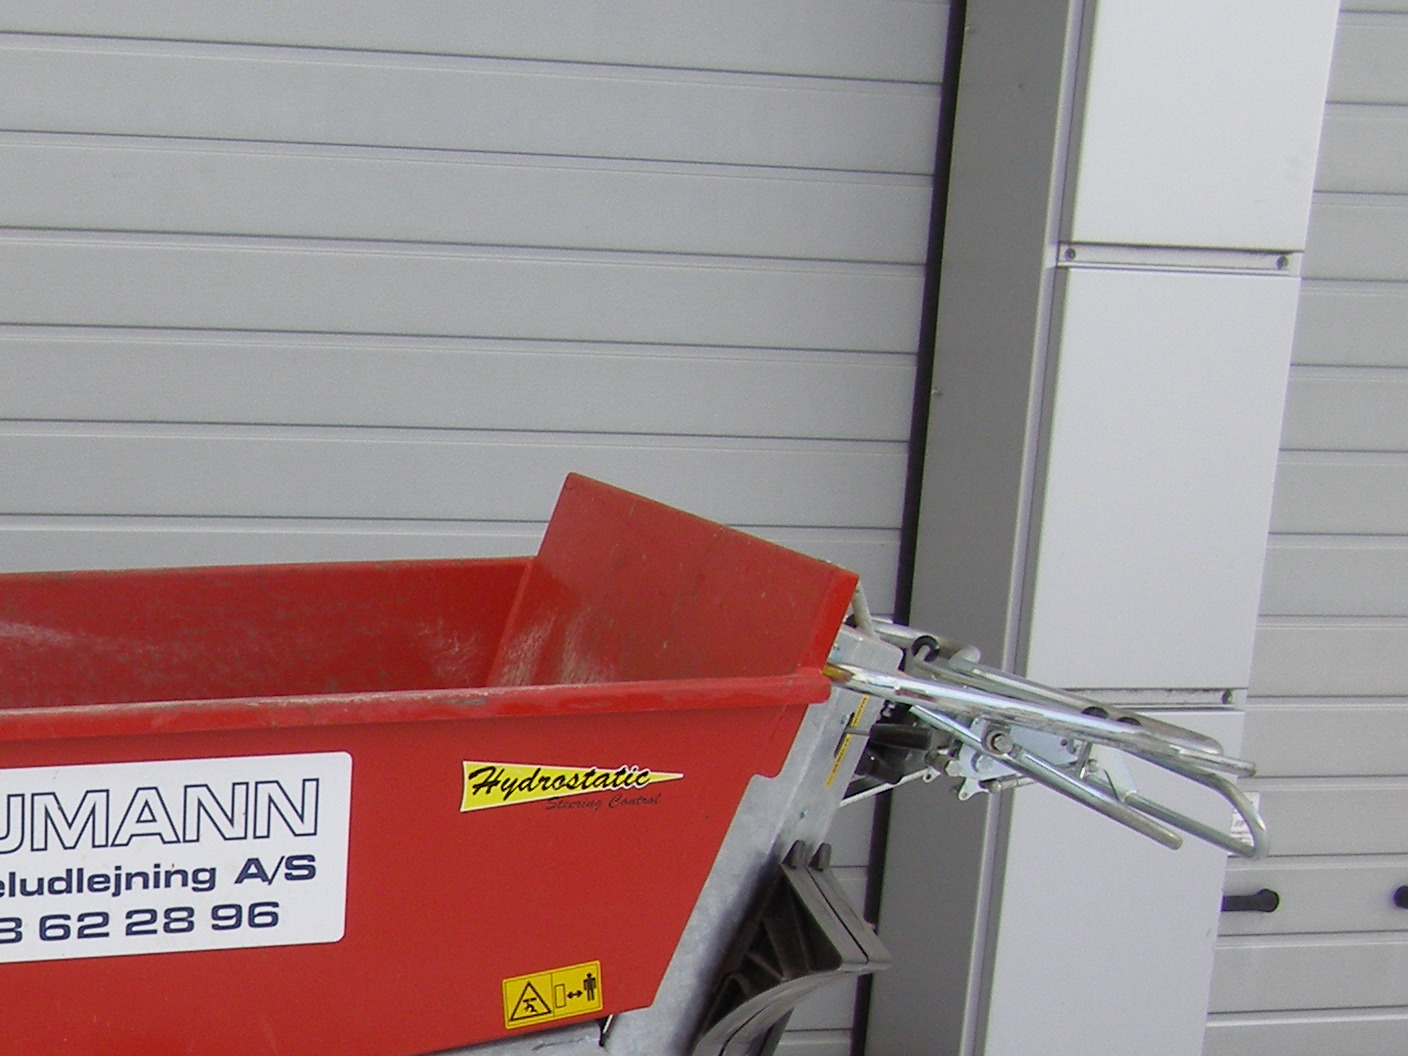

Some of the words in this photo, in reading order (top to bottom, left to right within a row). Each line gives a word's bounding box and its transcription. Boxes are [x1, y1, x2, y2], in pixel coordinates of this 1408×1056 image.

[468, 766, 651, 801] Hydrostatic
[234, 854, 317, 886] A/S
[38, 910, 110, 942] 62
[125, 906, 196, 937] 28
[211, 901, 280, 931] 96
